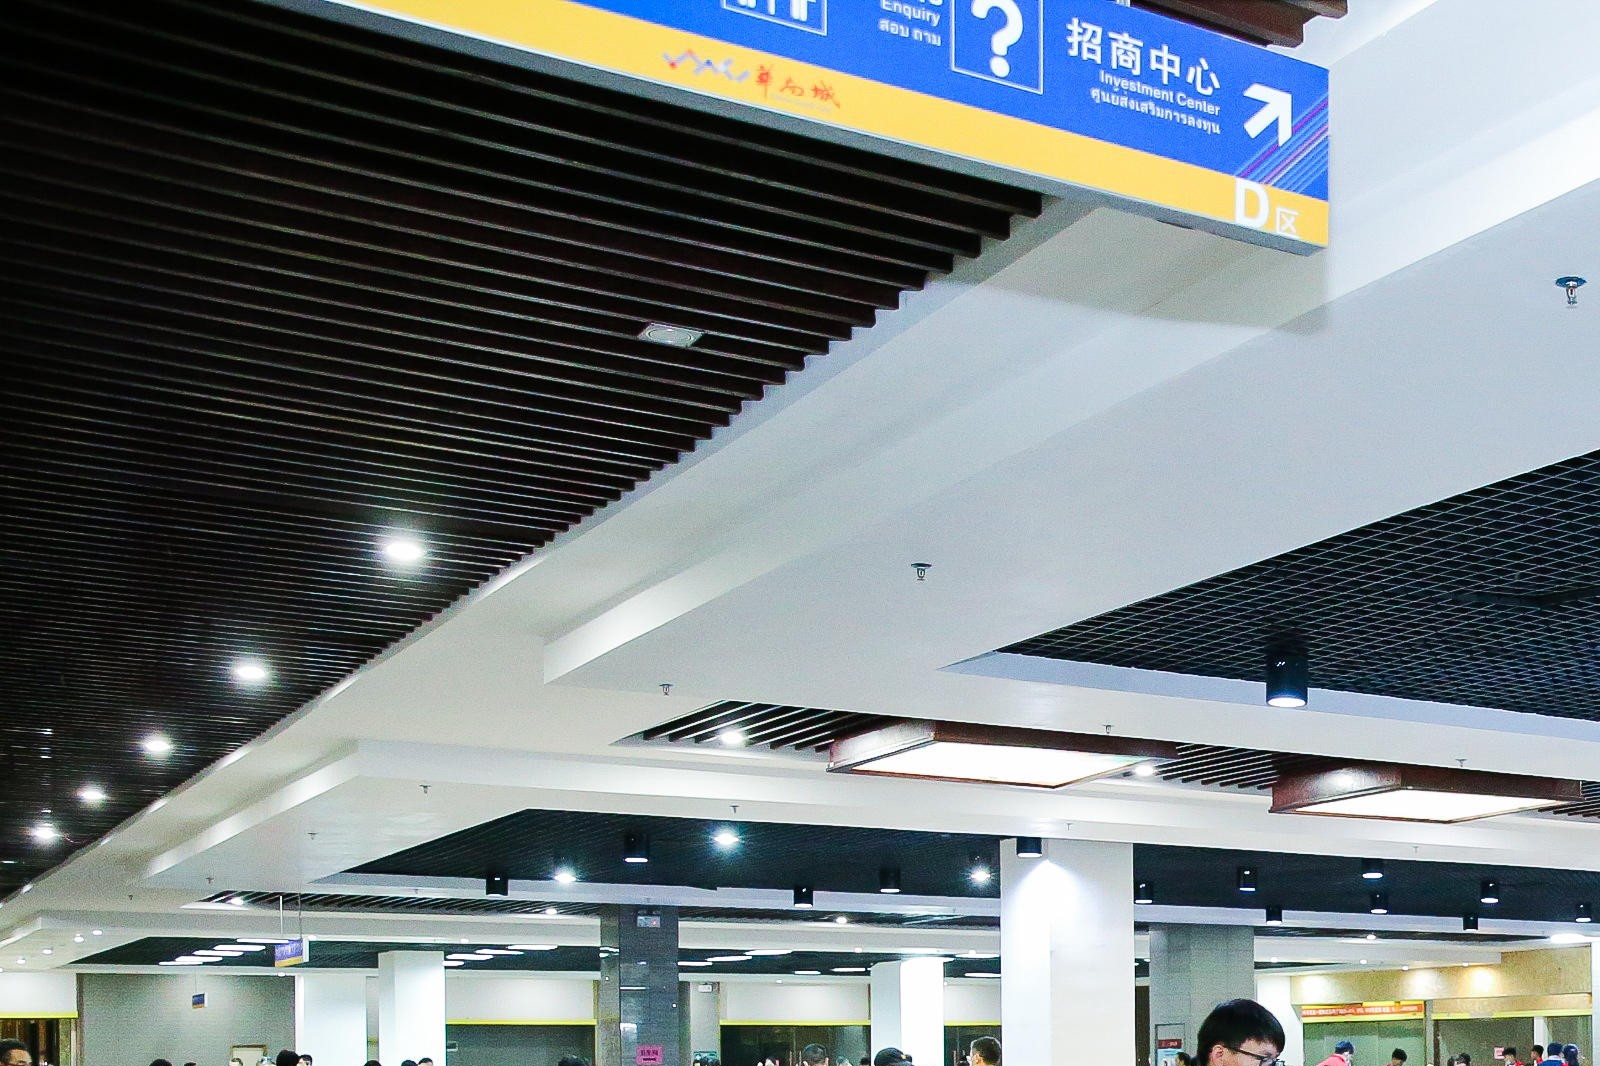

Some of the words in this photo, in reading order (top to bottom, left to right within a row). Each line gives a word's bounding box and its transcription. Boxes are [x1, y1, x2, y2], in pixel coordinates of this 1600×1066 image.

[880, 0, 941, 27] Enquiry
[1066, 17, 1221, 96] 招商中心
[1100, 70, 1174, 104] Investment
[1177, 91, 1221, 116] Center
